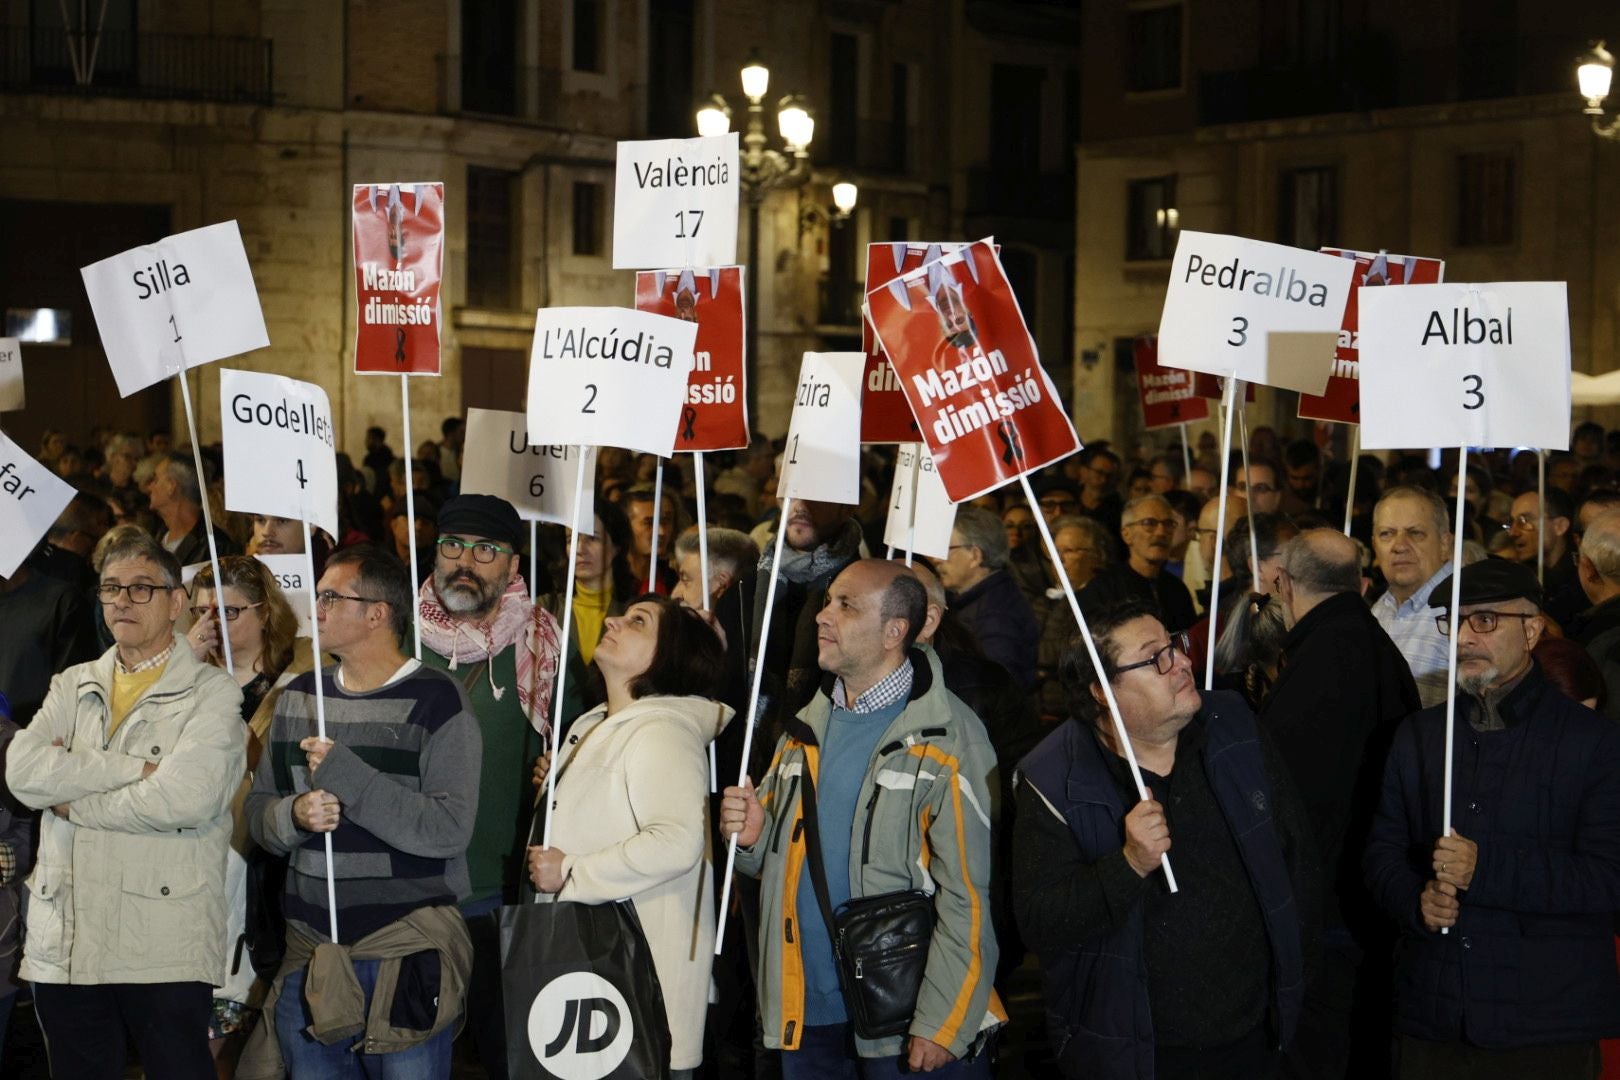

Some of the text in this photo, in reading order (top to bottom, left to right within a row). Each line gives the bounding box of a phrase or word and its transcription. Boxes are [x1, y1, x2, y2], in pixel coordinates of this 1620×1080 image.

[633, 156, 729, 189] València
[675, 210, 704, 238] 17
[133, 259, 191, 300] Silla
[362, 262, 415, 291] Mazón
[1185, 254, 1328, 308] Pedralba
[364, 297, 431, 325] dimissió
[1421, 307, 1512, 346] Albal
[168, 314, 182, 343] 1
[1227, 316, 1249, 347] 3
[543, 327, 674, 369] L'Alcúdia
[912, 346, 1009, 408] Mazón
[1462, 374, 1485, 410] 3
[581, 384, 598, 414] 2
[933, 367, 1041, 446] dimissió
[789, 433, 799, 464] 1
[296, 458, 308, 490] 4
[529, 474, 545, 498] 6
[544, 997, 621, 1059] JD
